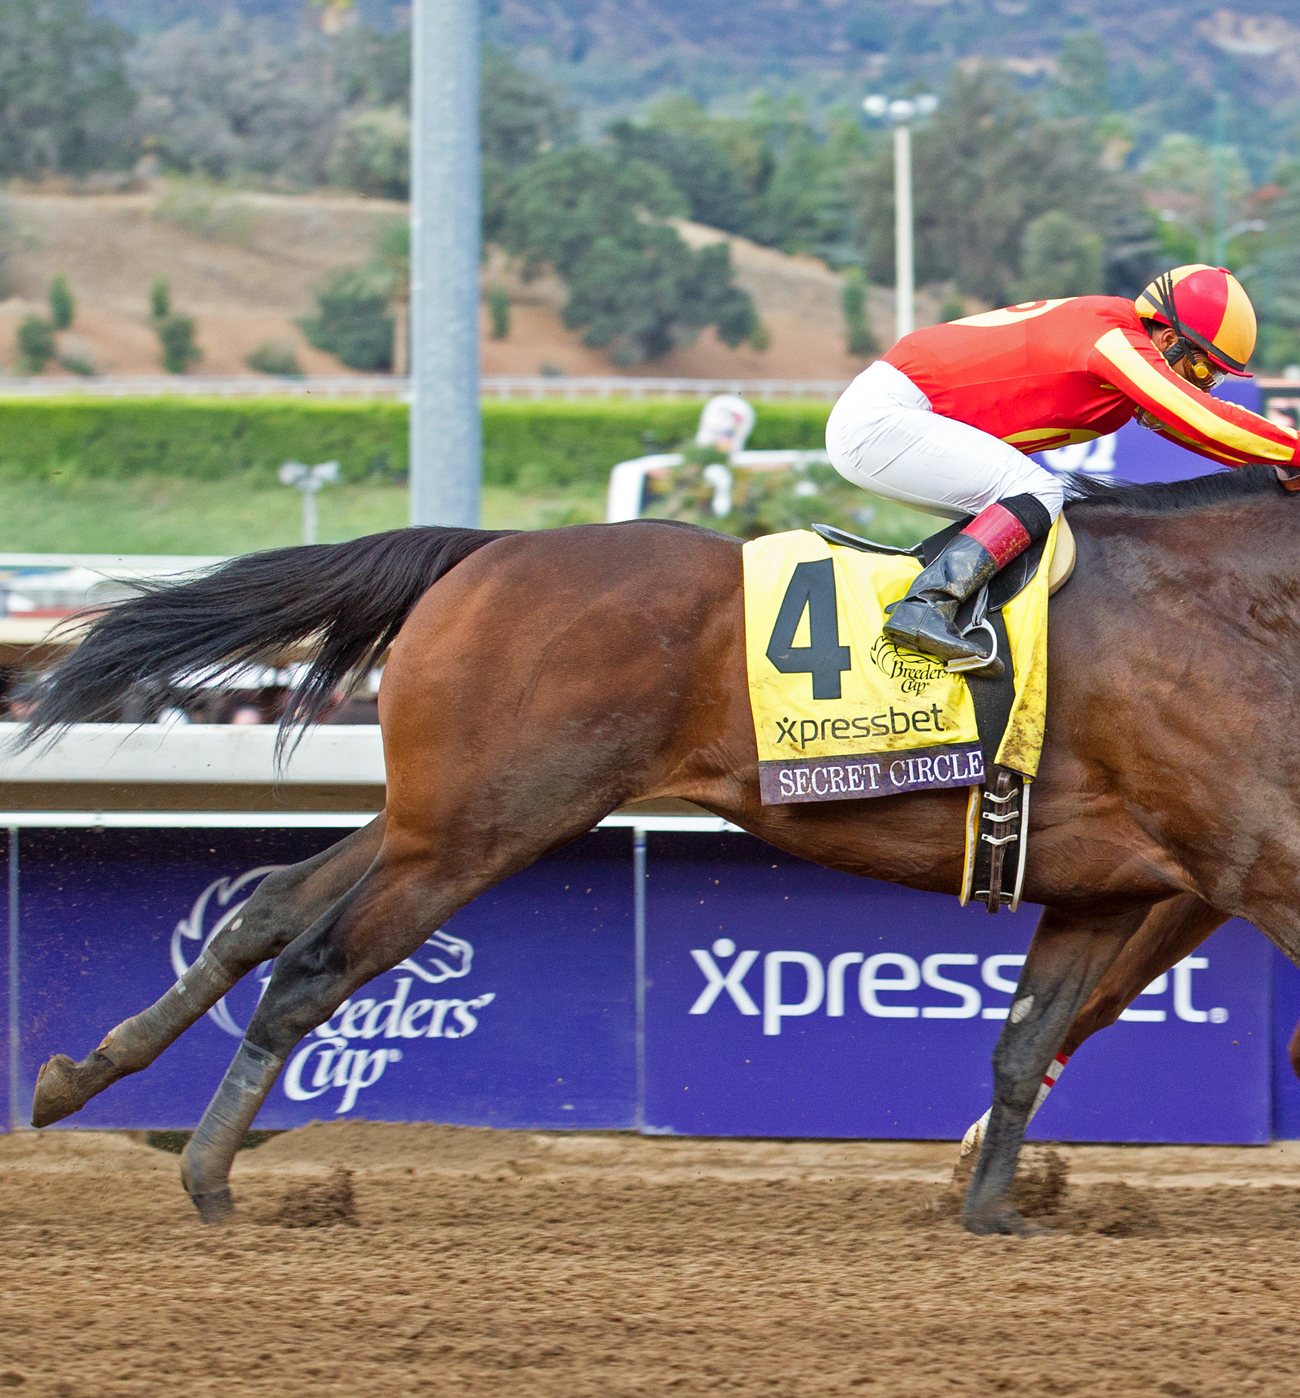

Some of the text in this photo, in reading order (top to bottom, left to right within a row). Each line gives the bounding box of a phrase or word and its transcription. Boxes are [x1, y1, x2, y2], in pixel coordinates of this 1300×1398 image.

[765, 557, 851, 699] 4
[900, 678, 927, 697] Cup
[775, 703, 945, 749] xpressbet
[779, 750, 985, 797] SECRET CIRCLE
[688, 938, 1210, 1036] xpresst
[283, 1037, 393, 1114] Cup
